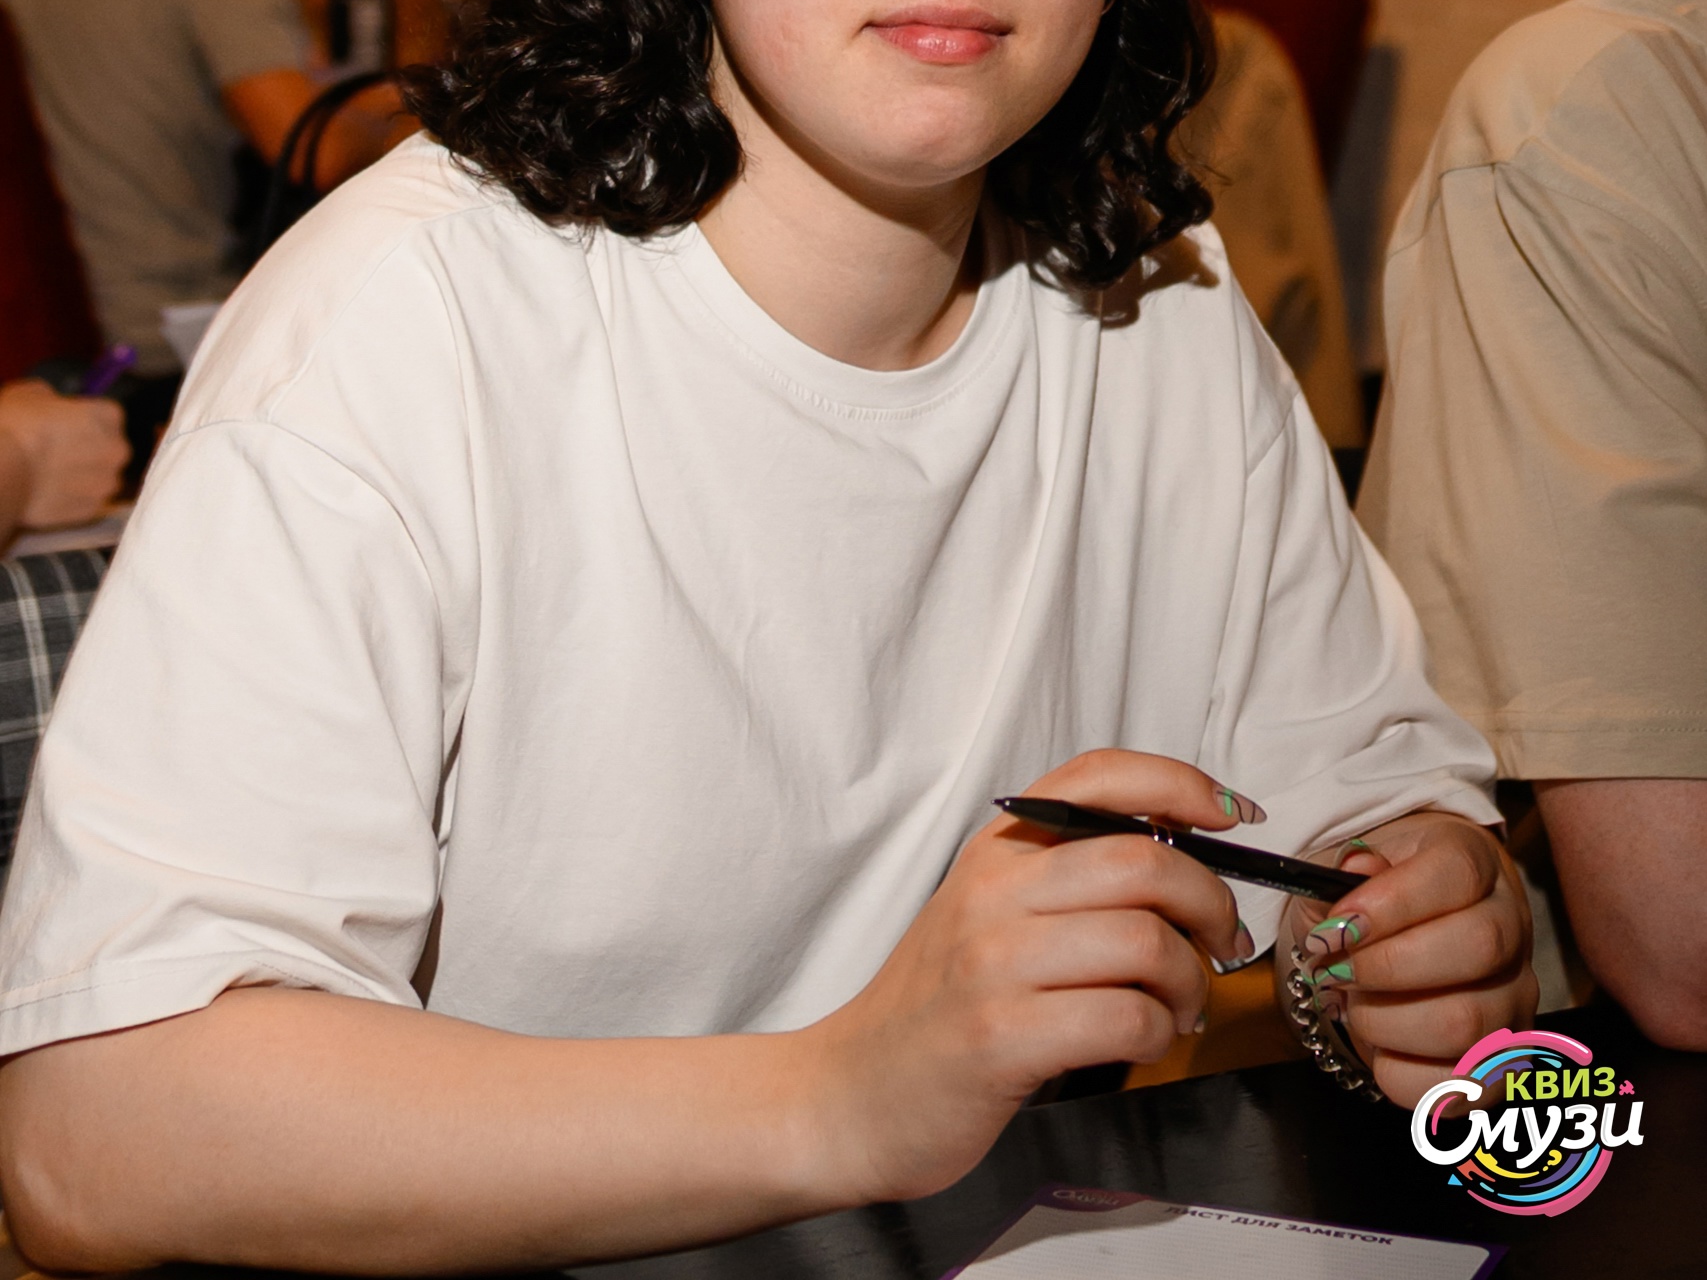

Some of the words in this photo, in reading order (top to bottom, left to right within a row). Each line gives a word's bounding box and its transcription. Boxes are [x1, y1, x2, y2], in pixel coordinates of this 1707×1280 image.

[1165, 1206, 1229, 1220] ЛИСТ
[1231, 1216, 1281, 1229] ДЛЯ
[1286, 1224, 1394, 1245] ЗАМЕТОК
